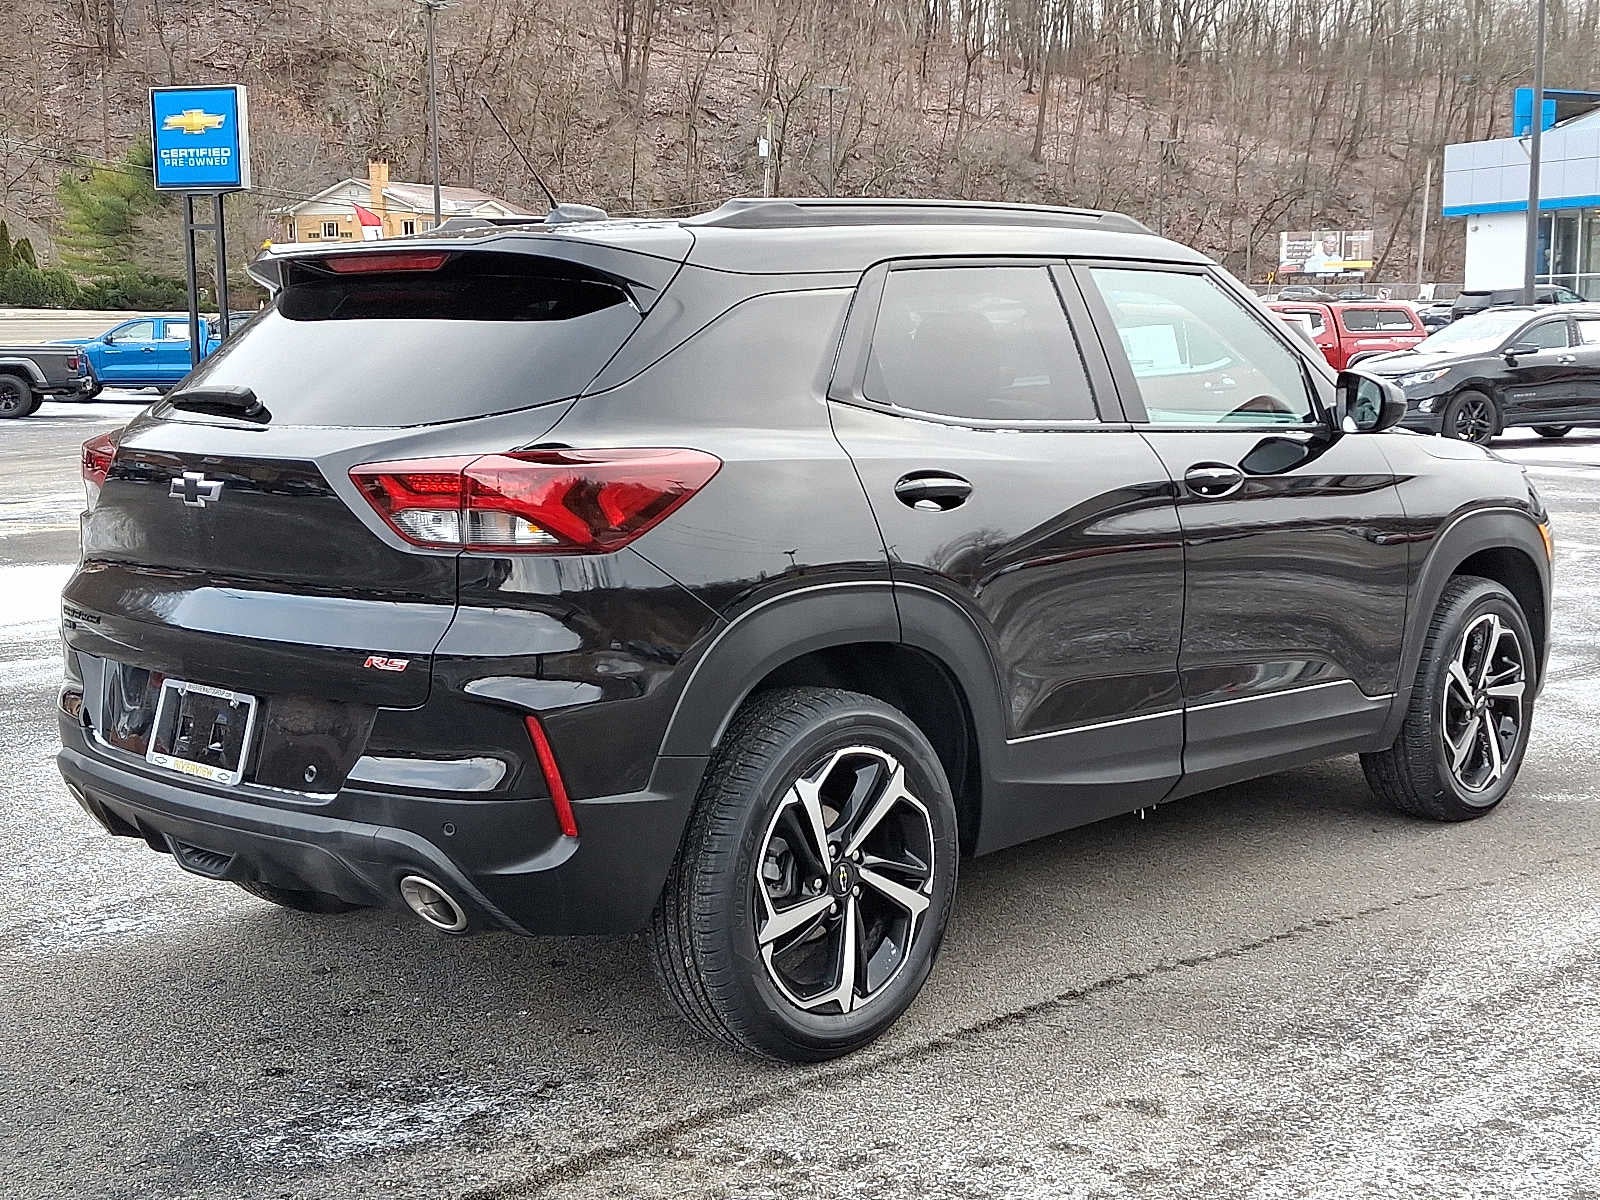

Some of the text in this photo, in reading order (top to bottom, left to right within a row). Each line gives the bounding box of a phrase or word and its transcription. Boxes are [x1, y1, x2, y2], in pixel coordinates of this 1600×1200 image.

[160, 148, 231, 159] CERTIFIED
[164, 157, 228, 167] PRE-OWNED
[363, 656, 410, 671] RS
[174, 759, 214, 777] RIVERVIEW
